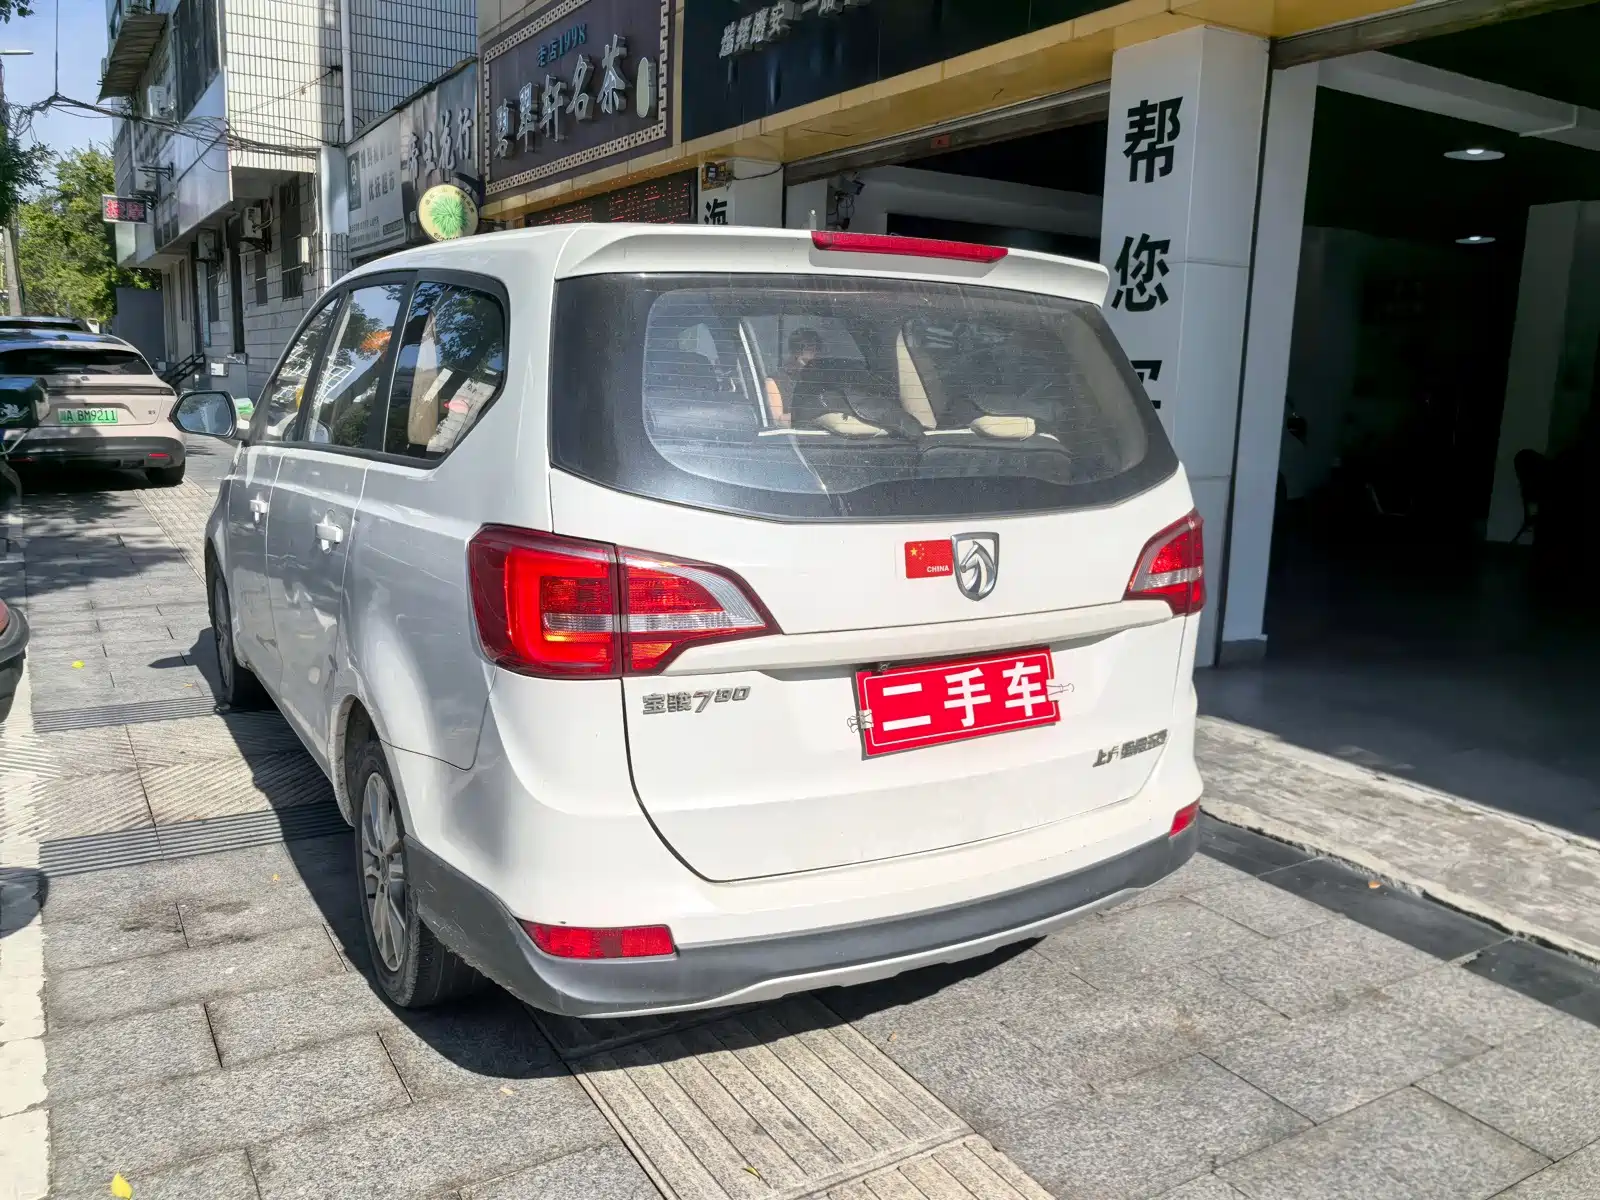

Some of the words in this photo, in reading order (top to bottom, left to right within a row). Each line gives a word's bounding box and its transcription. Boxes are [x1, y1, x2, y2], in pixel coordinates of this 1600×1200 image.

[77, 409, 116, 421] BM9211
[926, 565, 949, 573] CHINA
[883, 661, 1046, 731] 二手车
